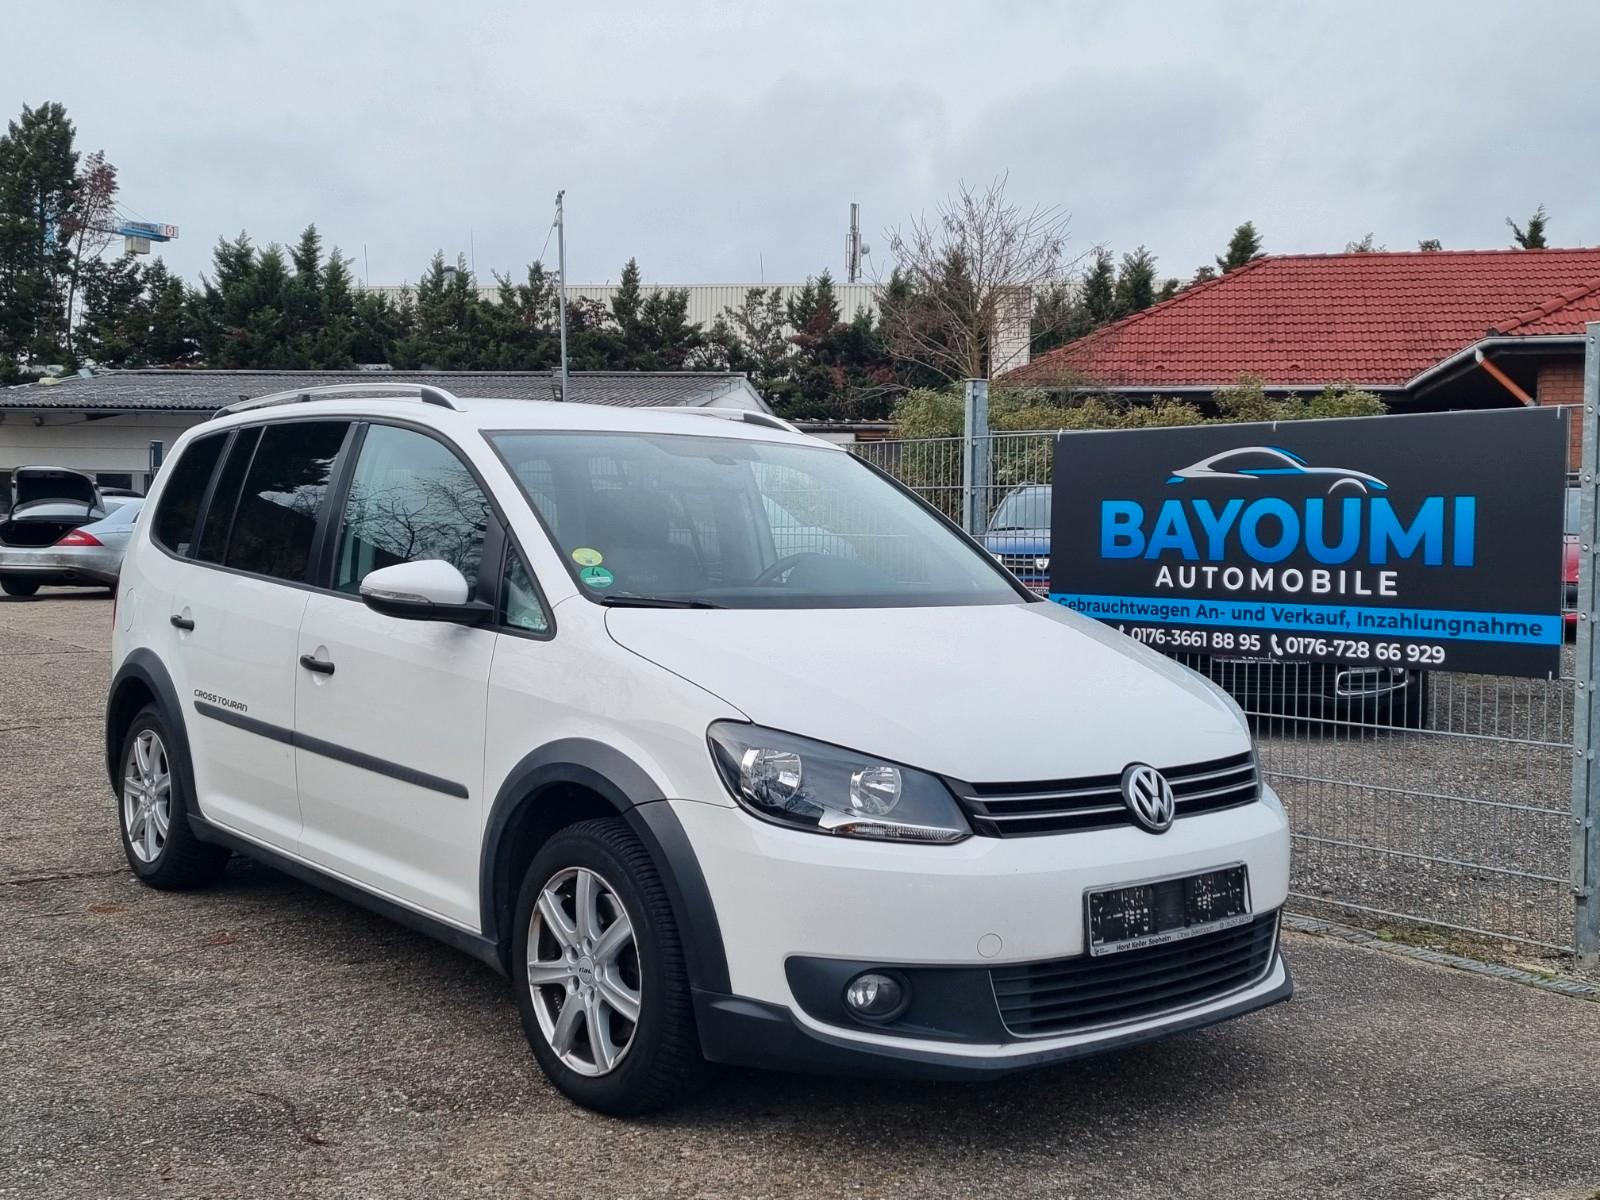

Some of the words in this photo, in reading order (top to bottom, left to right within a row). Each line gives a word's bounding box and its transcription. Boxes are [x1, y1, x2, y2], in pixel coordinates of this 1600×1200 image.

[1101, 496, 1476, 566] BAYOUMI
[1155, 566, 1398, 596] AUTOMOBILE
[1195, 604, 1226, 619] An-
[1231, 606, 1266, 621] und
[1271, 608, 1351, 629] Verkauf,
[1357, 611, 1544, 637] Inzahlungnahme
[1131, 627, 1208, 648] 0176-3661
[1212, 632, 1235, 649] 88
[1239, 633, 1261, 651] 95
[1285, 636, 1370, 659] 0176-728
[1375, 642, 1402, 661] 66
[1406, 644, 1446, 664] 929
